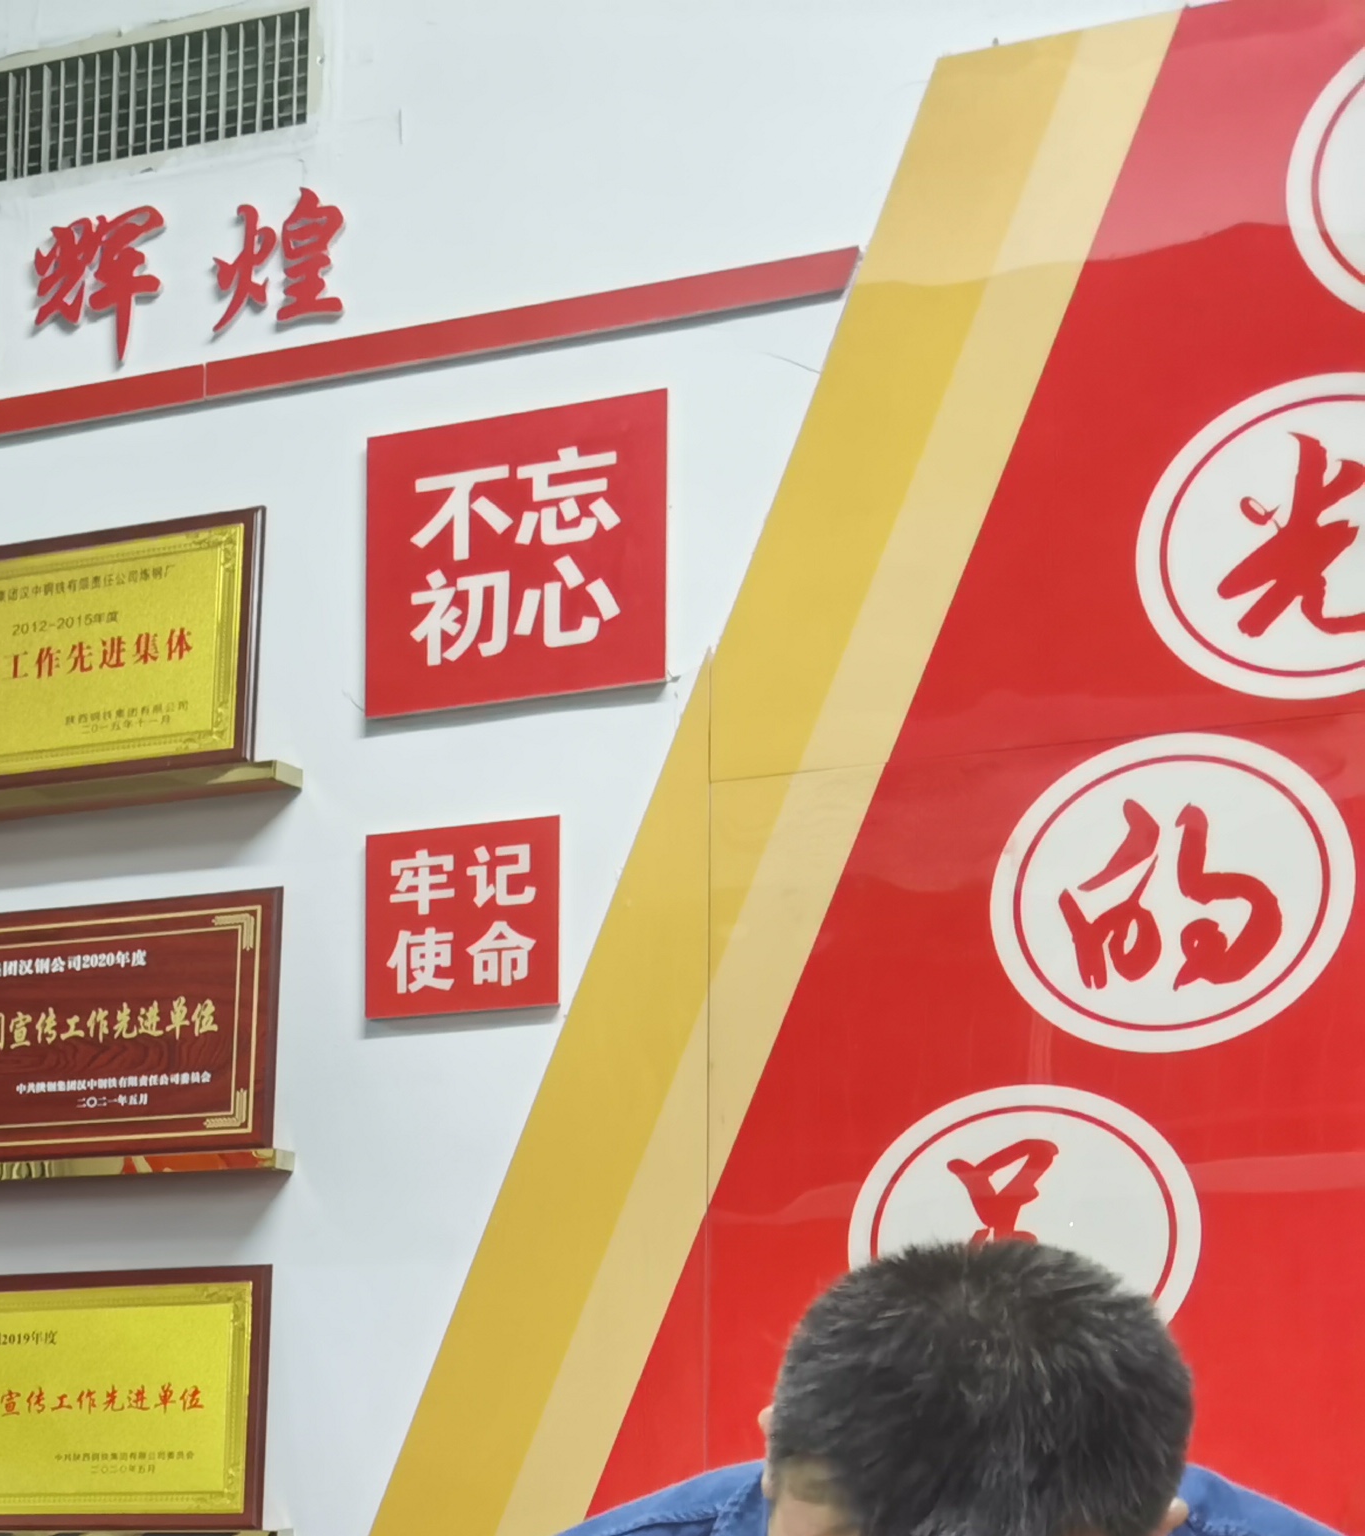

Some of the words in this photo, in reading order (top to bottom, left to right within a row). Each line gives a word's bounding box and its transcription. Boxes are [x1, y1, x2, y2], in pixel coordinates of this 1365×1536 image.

[410, 446, 621, 561] 不忘
[1217, 430, 1365, 639] 光
[12, 611, 120, 636] 2012-2015年度
[410, 555, 621, 667] 初心
[389, 843, 537, 915] 牢记
[1059, 798, 1282, 992] 的
[387, 921, 536, 994] 使命
